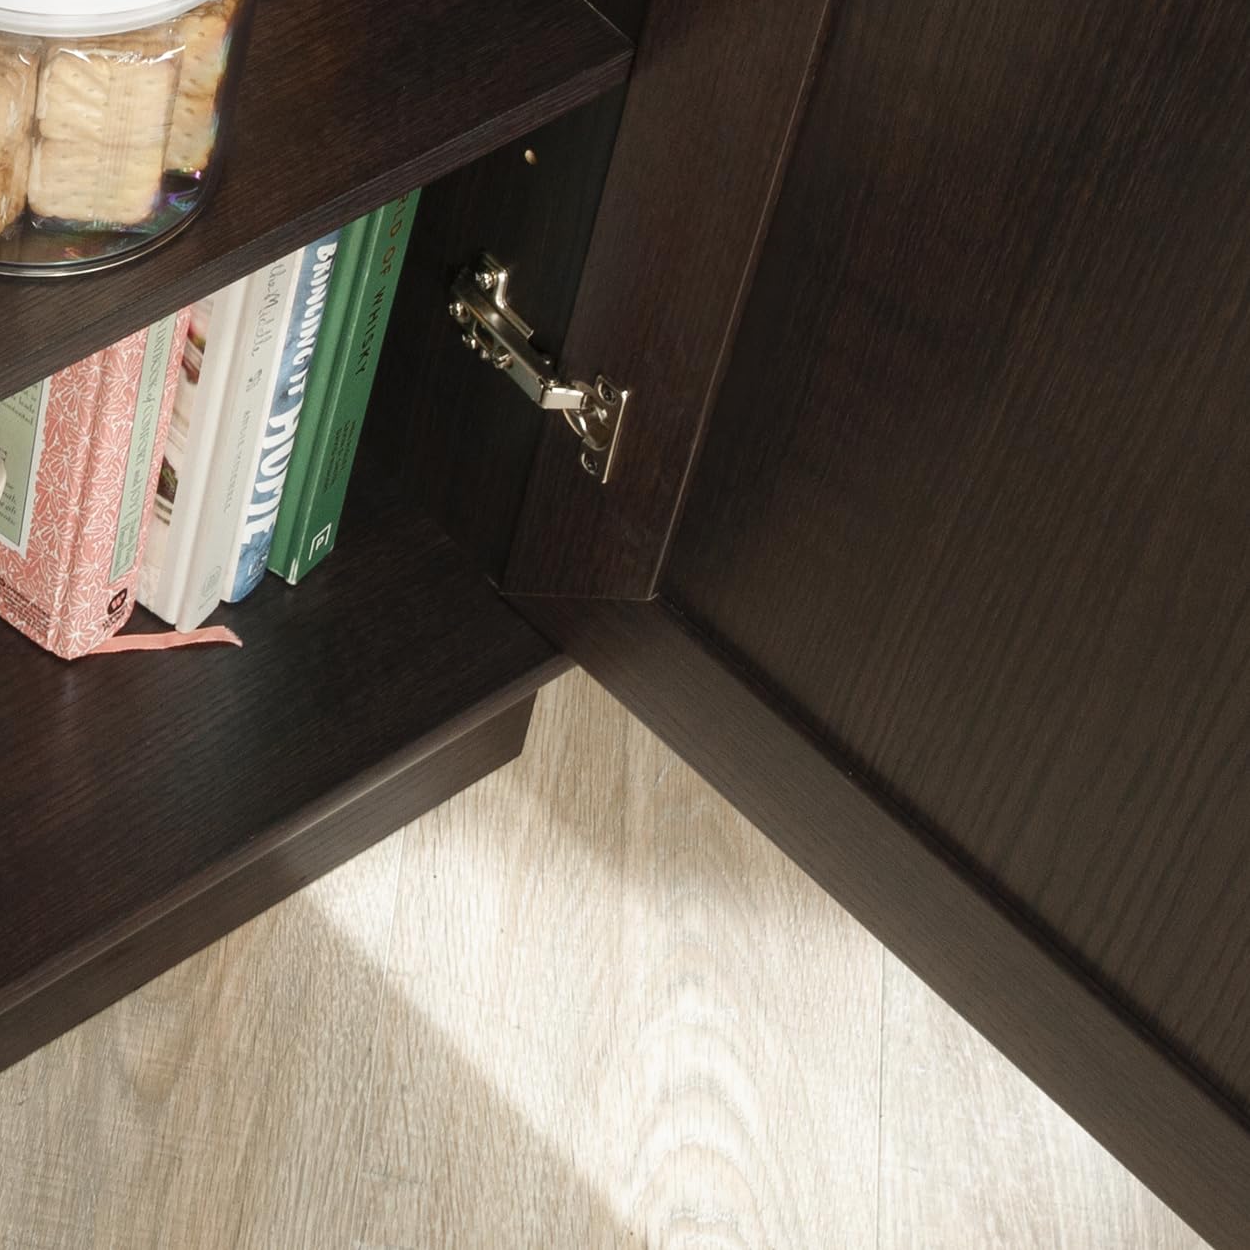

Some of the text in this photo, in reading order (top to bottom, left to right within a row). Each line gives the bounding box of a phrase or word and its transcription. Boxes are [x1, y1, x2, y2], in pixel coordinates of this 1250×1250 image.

[293, 242, 337, 365] BRINGING
[381, 245, 396, 276] OF
[355, 286, 386, 375] WHISKY
[288, 369, 308, 396] IT
[243, 399, 303, 544] HOME
